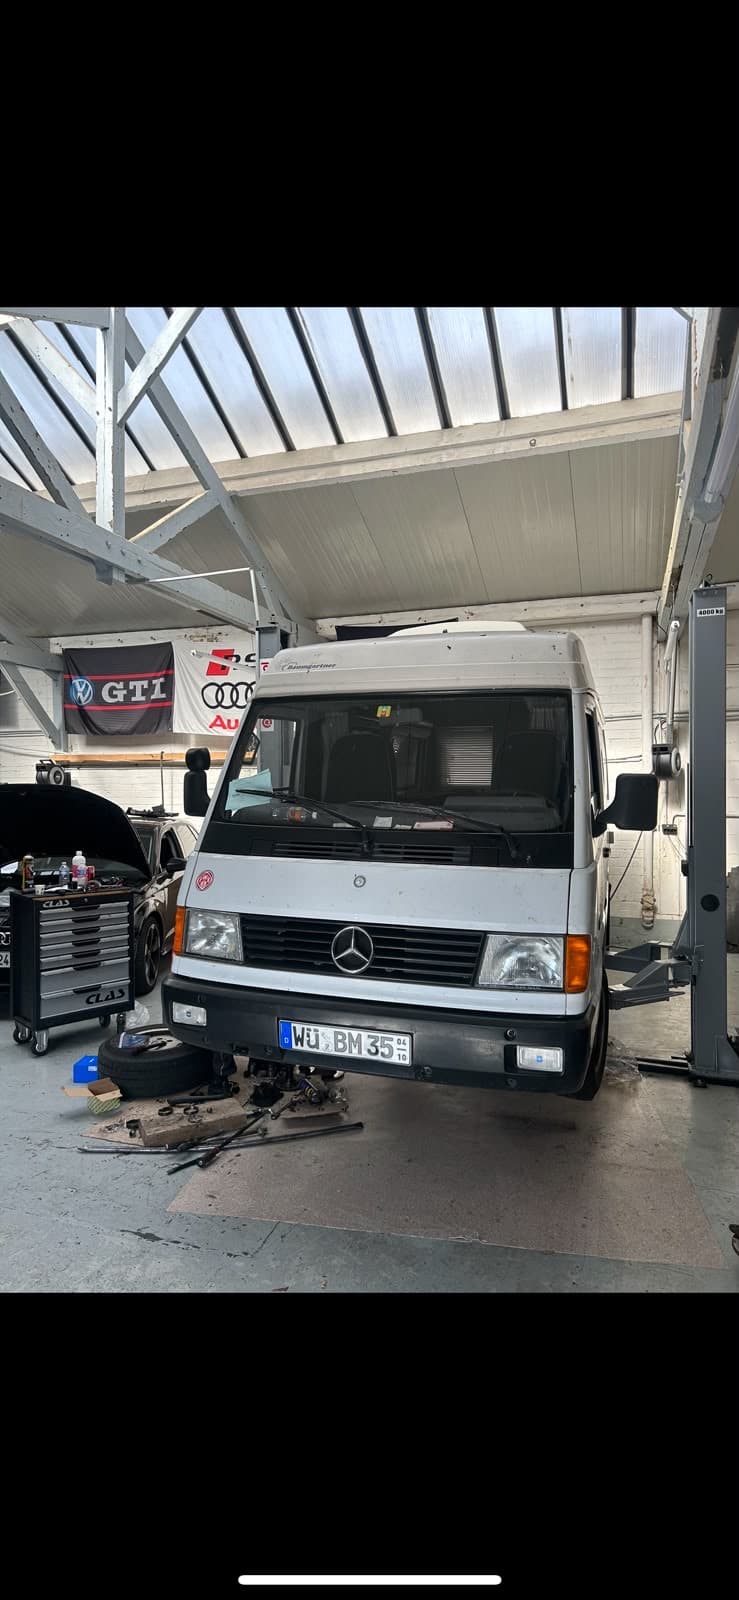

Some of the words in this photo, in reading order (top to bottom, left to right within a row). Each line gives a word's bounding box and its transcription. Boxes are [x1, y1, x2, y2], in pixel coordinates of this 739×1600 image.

[101, 677, 167, 703] GTI
[208, 714, 240, 730] Au
[42, 899, 70, 908] CLAS
[85, 988, 125, 1005] CLAS
[333, 1030, 363, 1055] BM
[367, 1034, 394, 1059] 35
[398, 1053, 407, 1062] 10
